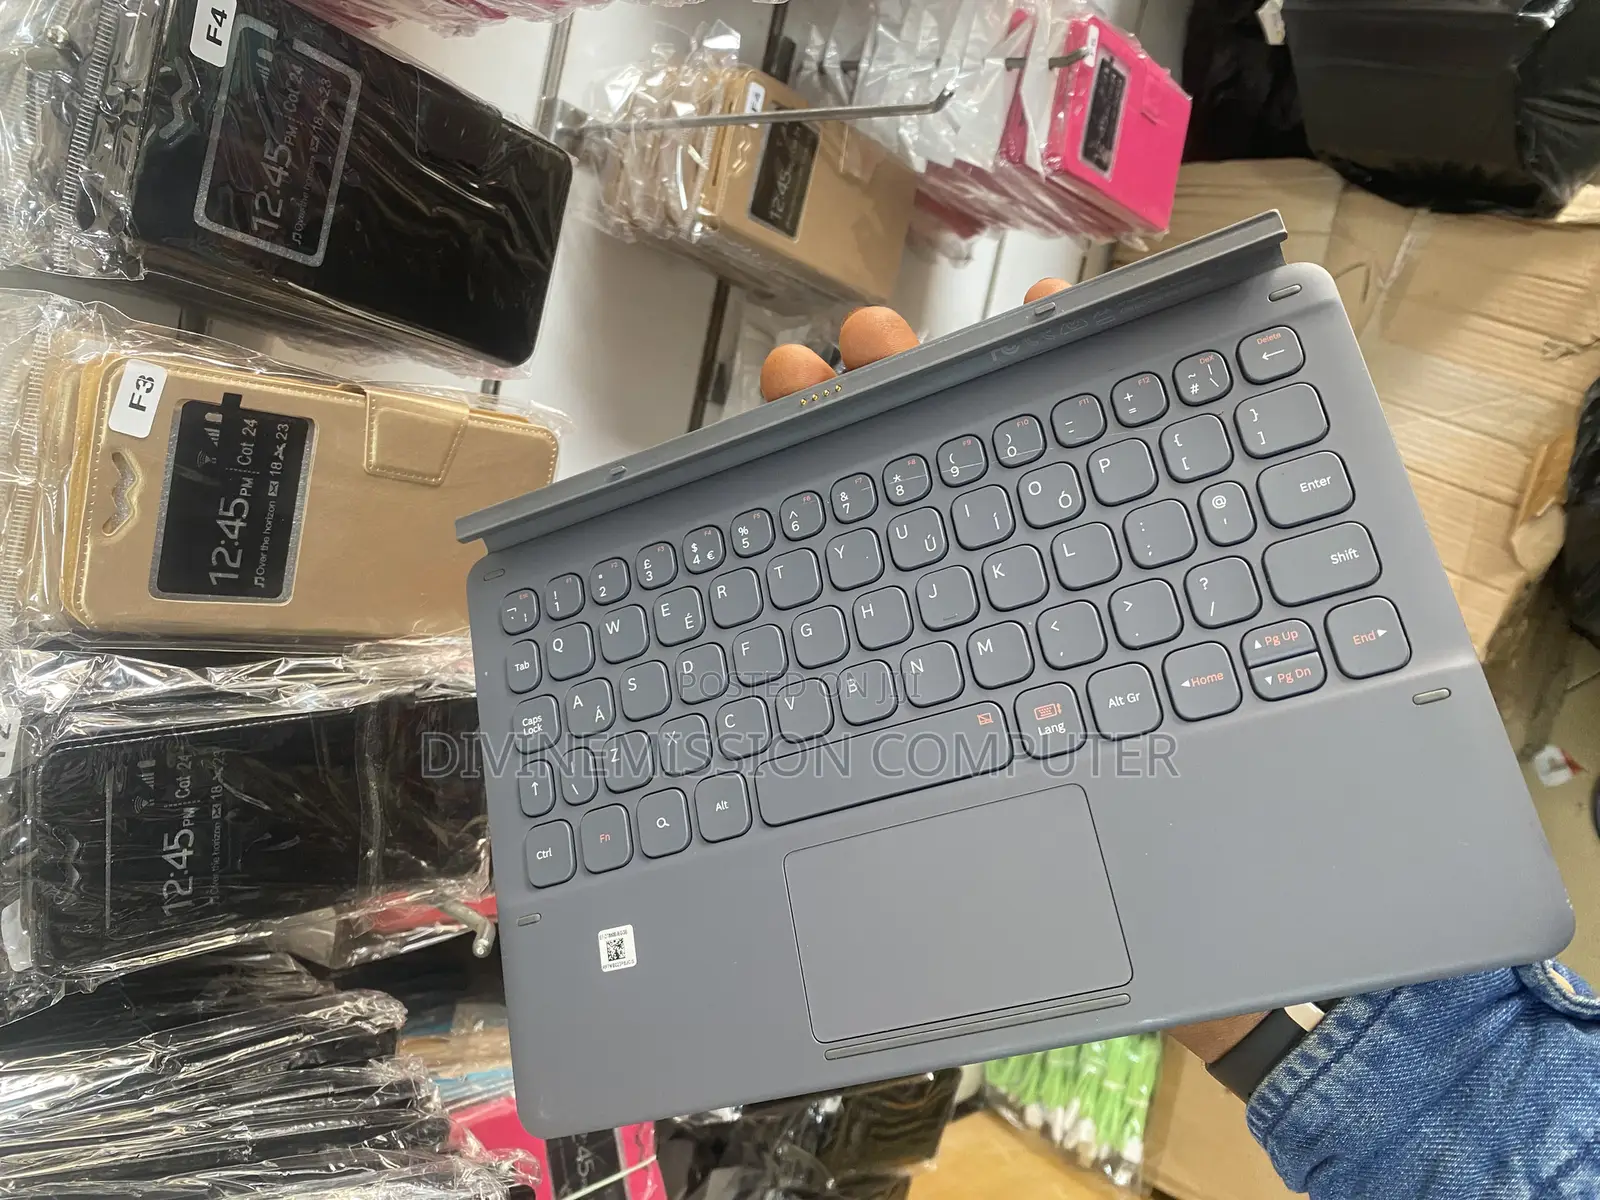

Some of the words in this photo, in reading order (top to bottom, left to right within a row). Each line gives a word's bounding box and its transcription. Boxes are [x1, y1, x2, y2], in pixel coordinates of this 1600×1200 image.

[206, 7, 228, 46] F4
[252, 144, 293, 231] 12:45
[284, 127, 300, 147] PM
[1256, 332, 1281, 345] Delete
[1199, 355, 1214, 365] DeX
[1138, 376, 1150, 387] F12
[1190, 383, 1200, 395] #
[129, 375, 154, 412] F3
[242, 418, 259, 437] 24
[1016, 419, 1029, 428] F10
[276, 422, 289, 441] 23
[270, 461, 283, 477] 18
[951, 465, 960, 477] 9
[1098, 458, 1110, 474] P
[895, 485, 905, 496] 8
[1028, 481, 1042, 496] O
[1300, 476, 1332, 493] Enter
[840, 492, 849, 502] &
[1211, 495, 1227, 509] @
[842, 503, 850, 514] 7
[263, 501, 277, 533] horizon
[208, 497, 250, 585] 12:45
[240, 478, 254, 497] PM
[738, 526, 749, 536] %
[791, 521, 800, 532] 6
[896, 524, 908, 540] U
[261, 534, 270, 550] the
[691, 543, 698, 553] $
[741, 538, 750, 549] 5
[924, 534, 937, 552] Ú
[706, 550, 715, 560] €
[834, 544, 845, 559] Y
[1062, 543, 1076, 557] L
[1330, 548, 1360, 565] Shift
[255, 550, 268, 576] Over
[643, 559, 652, 570] £
[693, 554, 701, 565] 4
[645, 571, 653, 581] 3
[774, 565, 784, 579] T
[992, 563, 1005, 579] K
[599, 586, 607, 597] 2
[928, 583, 937, 599] J
[1199, 577, 1209, 591] ?
[717, 585, 727, 599] R
[554, 602, 560, 612] 1
[661, 603, 671, 617] E
[861, 603, 874, 619] H
[605, 619, 620, 634] W
[684, 613, 694, 630] É
[800, 623, 813, 638] G
[1353, 629, 1377, 646] End
[552, 638, 563, 653] Q
[1264, 634, 1281, 648] Pg
[1282, 629, 1299, 645] Up
[741, 641, 750, 656] F
[977, 638, 994, 655] M
[514, 661, 530, 672] Tab
[682, 660, 693, 674] D
[910, 658, 924, 674] N
[1191, 670, 1224, 687] Home
[1277, 672, 1294, 686] Pg
[1295, 666, 1312, 680] Dn
[627, 678, 638, 691] S
[849, 678, 858, 694] B
[572, 695, 584, 709] A
[784, 696, 795, 711] V
[1107, 694, 1125, 709] Alt
[1126, 692, 1141, 705] Gr
[522, 714, 542, 728] Caps
[724, 714, 736, 728] C
[1037, 720, 1066, 736] Lang
[523, 723, 543, 736] Lock
[667, 730, 678, 746] X
[610, 748, 620, 762] Z
[211, 784, 223, 800] 18
[715, 800, 729, 812] Alt
[600, 833, 611, 843] Fn
[536, 847, 552, 860] Ctrl
[162, 829, 195, 916] 12:45
